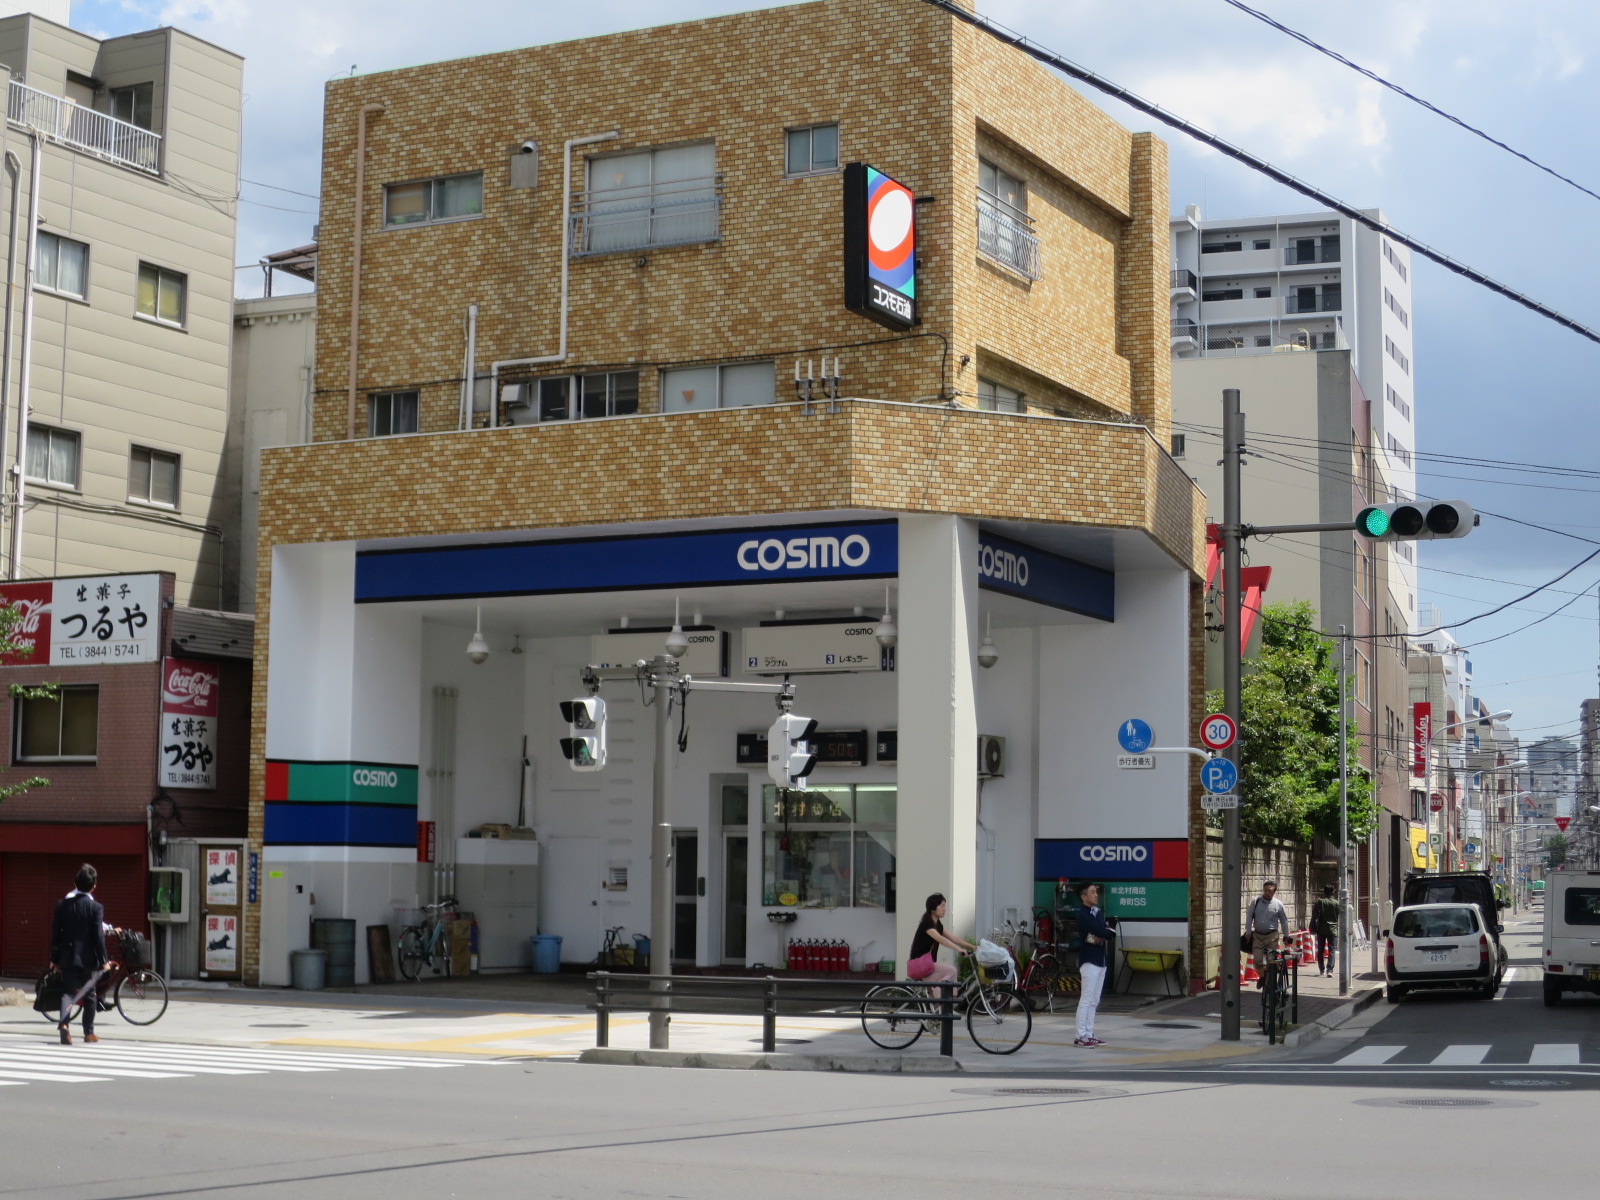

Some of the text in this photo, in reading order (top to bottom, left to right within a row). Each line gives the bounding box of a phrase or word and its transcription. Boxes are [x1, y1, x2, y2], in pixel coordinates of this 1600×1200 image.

[873, 284, 912, 320] コスモ石油
[736, 533, 871, 571] COSMO
[76, 582, 132, 602] 生菓子
[60, 602, 148, 641] つるや
[687, 635, 715, 643] COSMO
[844, 627, 874, 636] COSMO
[839, 655, 869, 664] レギュラー
[171, 717, 208, 738] 生菓子
[1208, 724, 1228, 740] 30
[164, 741, 213, 773] つるや
[1118, 757, 1151, 766] 歩行者優先
[354, 769, 397, 787] COSMO
[1208, 767, 1223, 790] P
[208, 852, 236, 866] 探偵
[1079, 845, 1148, 862] COSMO
[207, 918, 235, 932] 探偵
